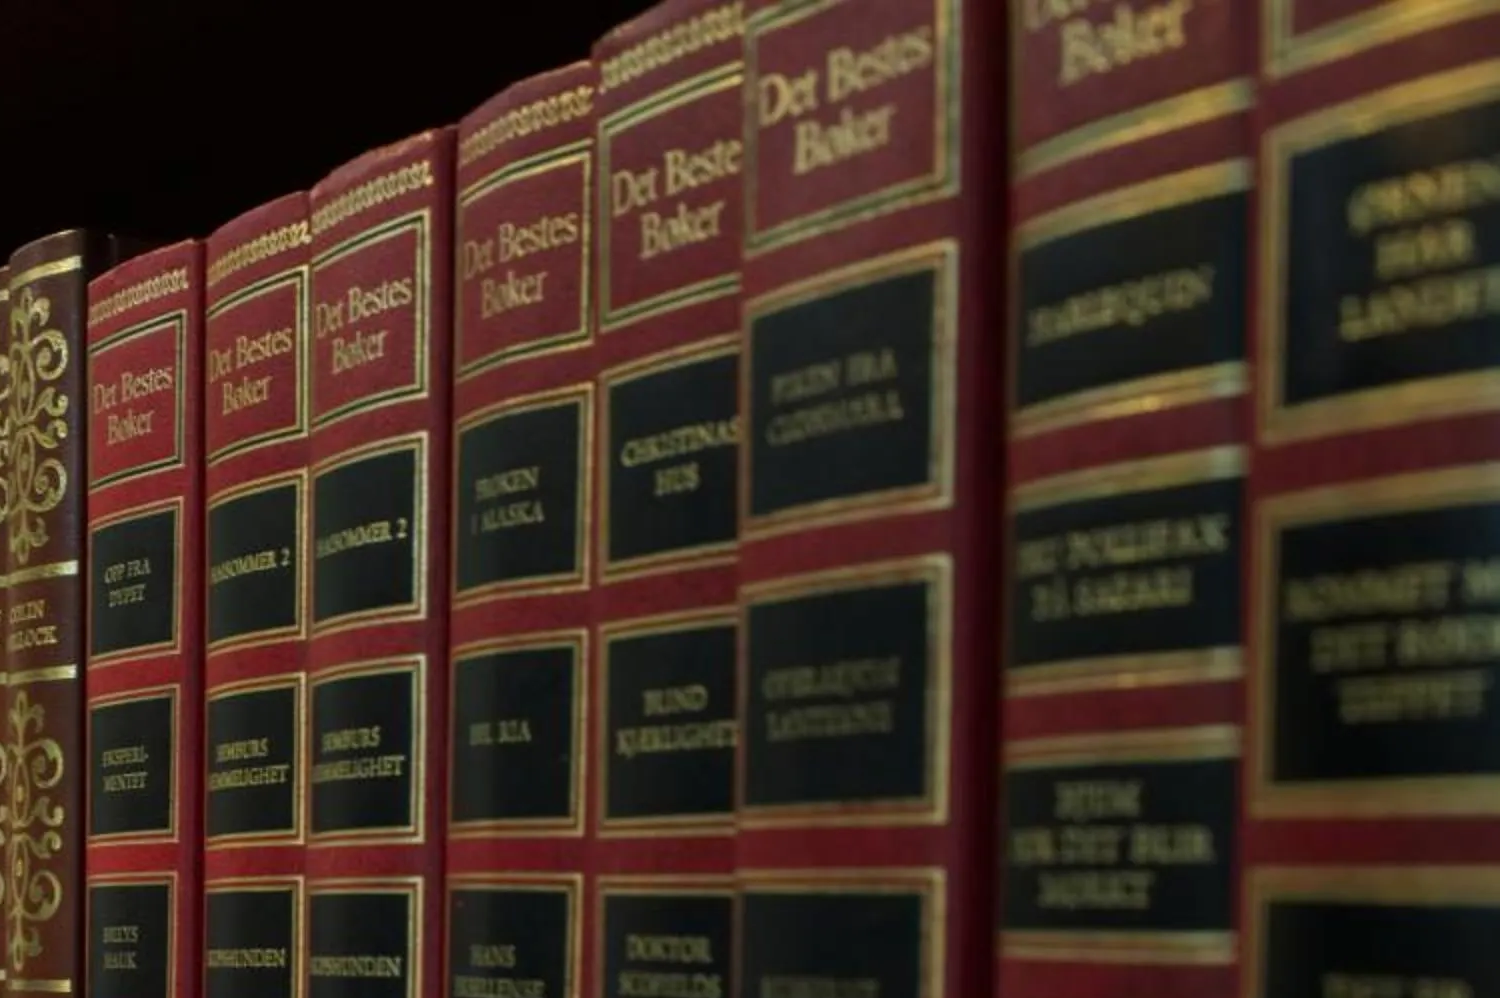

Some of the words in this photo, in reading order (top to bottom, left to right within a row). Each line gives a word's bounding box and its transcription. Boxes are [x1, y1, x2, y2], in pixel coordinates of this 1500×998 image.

[827, 25, 933, 101] Bestes
[611, 168, 659, 217] Det
[663, 138, 742, 197] Beste
[498, 212, 578, 262] Bestes
[348, 276, 412, 321] Bestes
[236, 326, 292, 368] Bestes
[121, 367, 173, 402] Bestes
[396, 517, 407, 539] 2
[479, 499, 544, 534] ALASKA
[127, 556, 152, 577] FRA
[280, 547, 291, 567] 2
[642, 685, 708, 716] BLIND
[626, 934, 713, 963] DOKTOR
